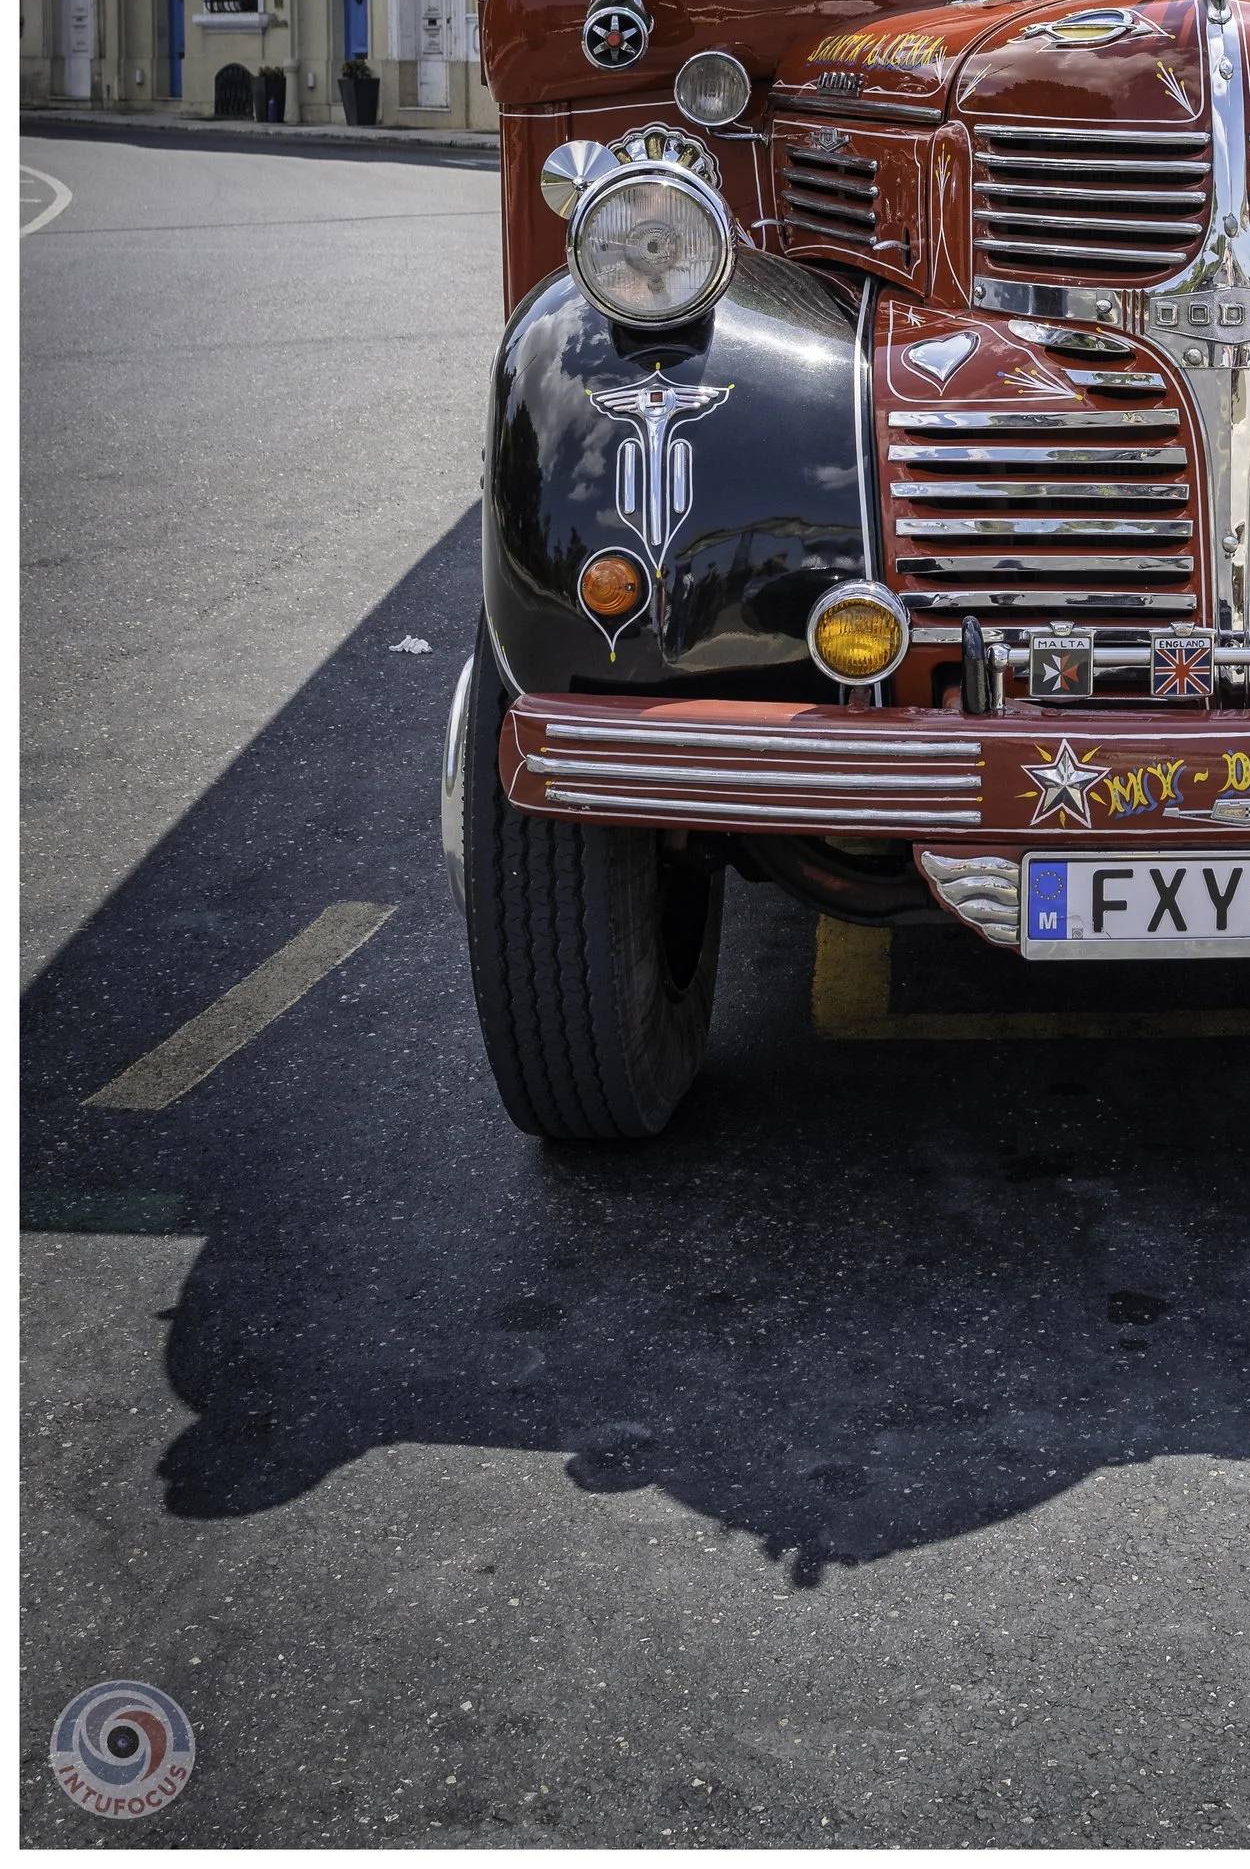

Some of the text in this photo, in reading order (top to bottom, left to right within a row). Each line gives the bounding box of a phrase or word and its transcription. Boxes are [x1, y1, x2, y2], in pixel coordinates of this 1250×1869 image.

[1037, 640, 1085, 649] MALTA
[1158, 639, 1206, 649] ENGLAND
[1091, 867, 1244, 932] FXY
[1039, 911, 1058, 930] M
